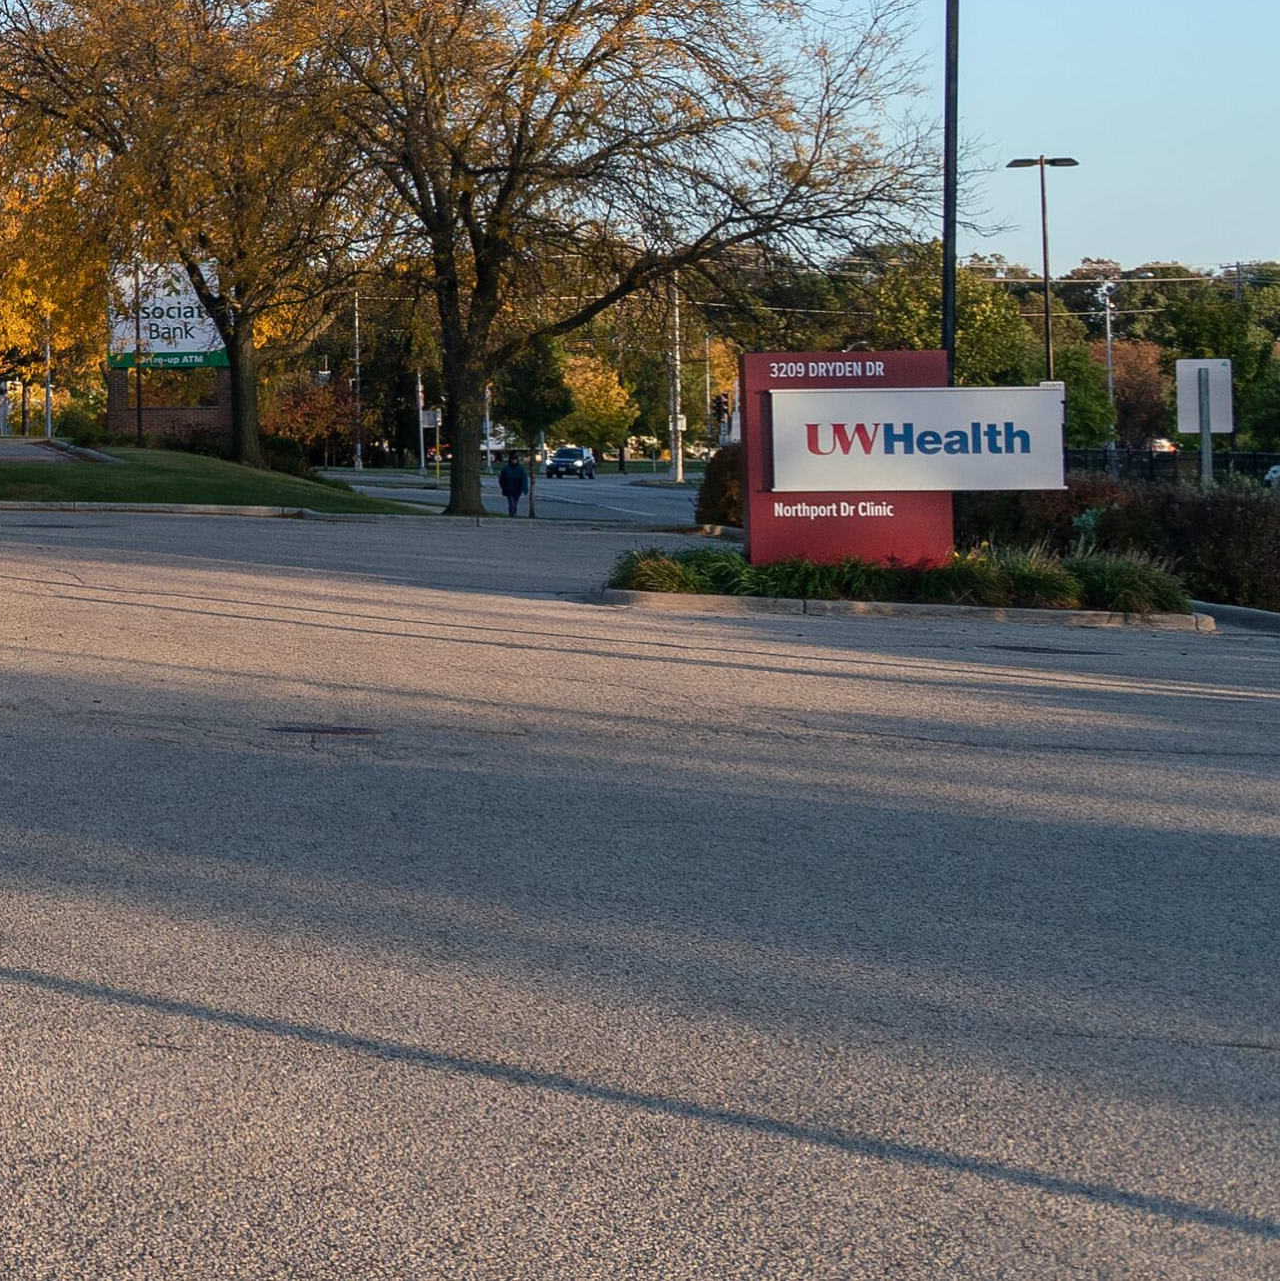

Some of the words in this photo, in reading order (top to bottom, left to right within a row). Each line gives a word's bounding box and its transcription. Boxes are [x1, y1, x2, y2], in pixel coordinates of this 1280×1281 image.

[148, 322, 195, 340] Bank
[181, 355, 204, 365] ATM
[768, 361, 806, 378] 3209
[807, 361, 862, 378] DRYDEN
[865, 361, 885, 377] DR
[773, 502, 838, 520] Northport
[840, 502, 856, 517] Dr
[857, 502, 895, 517] Clinic
